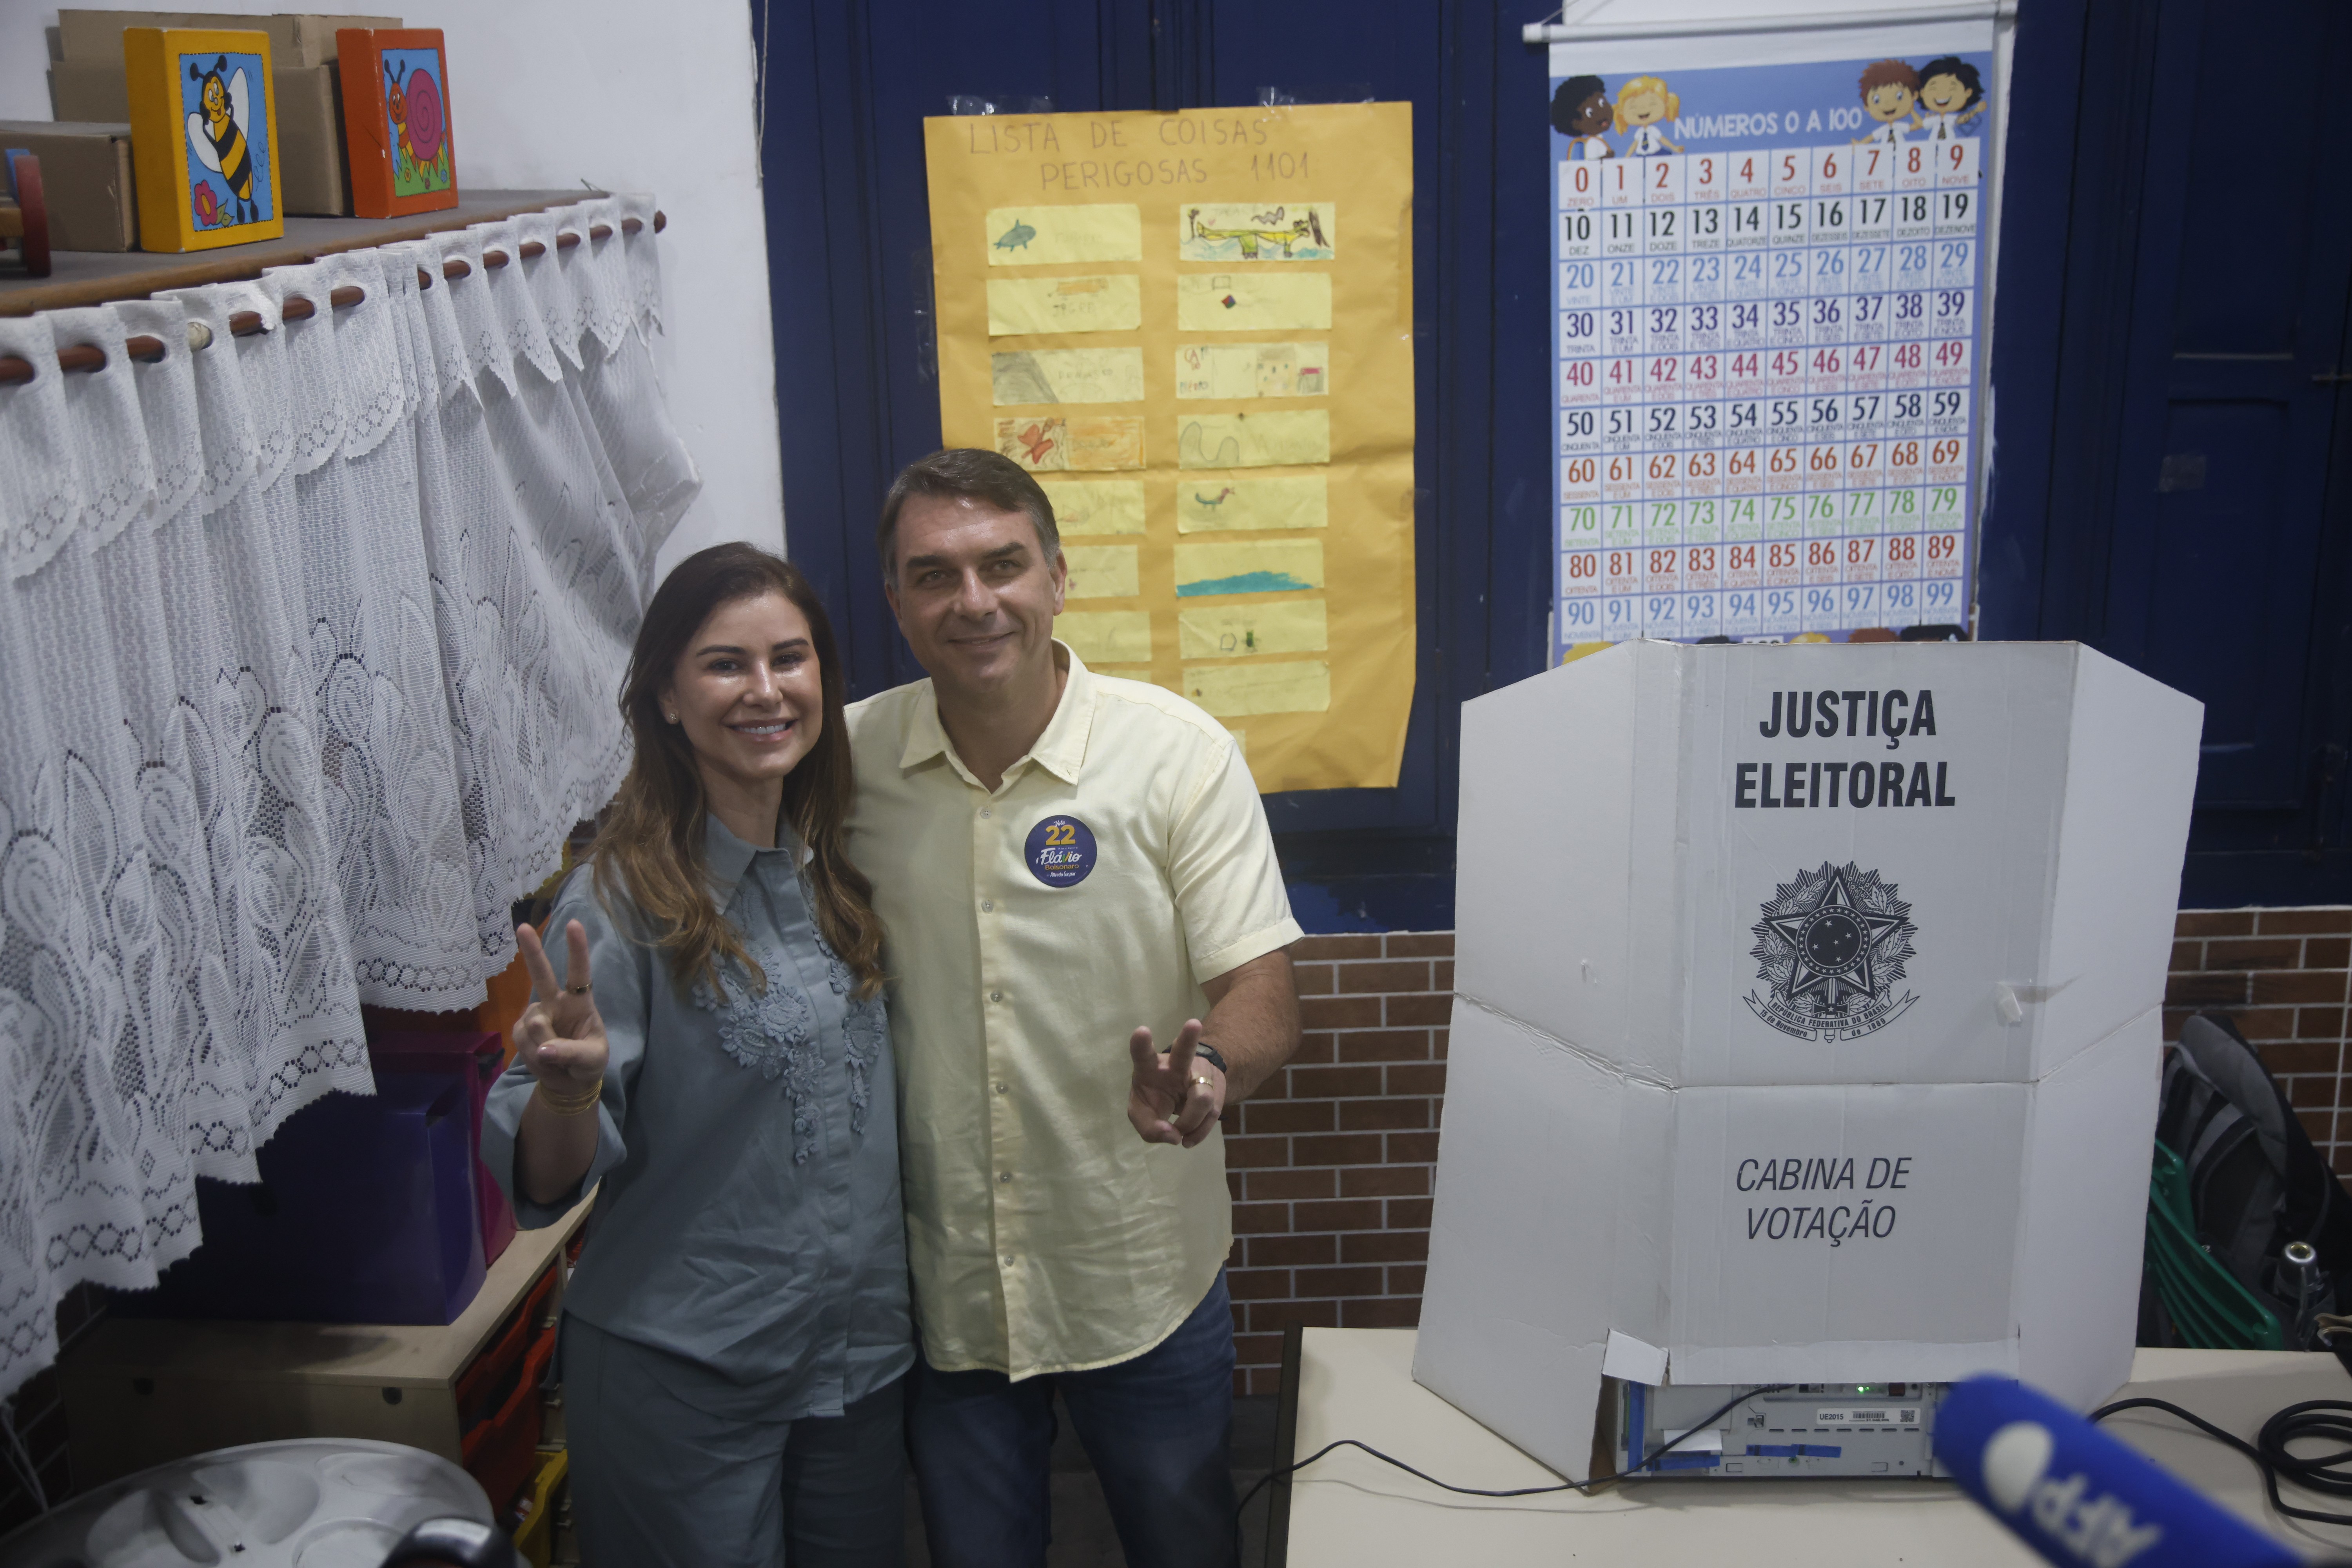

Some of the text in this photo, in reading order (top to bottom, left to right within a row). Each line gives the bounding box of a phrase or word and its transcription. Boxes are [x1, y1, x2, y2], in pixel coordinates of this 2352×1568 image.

[970, 118, 1267, 154] LISTA DE COISAS
[1673, 107, 1862, 140] NÚMEROS 0 A 100
[1041, 152, 1309, 191] PERIGOSAS 1101
[1575, 144, 1964, 192] 0 1 2 3 4 5 6 7 8 9
[1568, 174, 1969, 207] ZERO UM DOIS TRÊS QUATRO CINCO SEIS SETE OITO NOVE
[1564, 192, 1969, 241] 10 11 12 13 14 15 16 17 18 19
[1569, 246, 1589, 255] DEZ
[1607, 243, 1635, 253] ONZE
[1649, 241, 1677, 252] DOZE
[1693, 238, 1719, 249] TREZE
[1727, 236, 1766, 247] QUATORZE
[1772, 234, 1804, 244] QUINZE
[1896, 226, 1930, 237] DEZOITO
[1935, 224, 1976, 234] DEZENOVE
[1567, 242, 1969, 289] 20 21 22 23 24 25 26 27 28 29
[1566, 290, 1965, 338] 30 31 32 33 34 35 36 37 38 39
[1566, 341, 1964, 387] 40 41 42 43 44 45 46 47 48 49
[1566, 391, 1961, 437] 50 51 52 53 54 55 56 57 58 59
[1568, 439, 1960, 483] 60 61 62 63 64 65 66 67 68 69
[1571, 488, 1957, 531] 70 71 72 73 74 75 76 77 78 79
[1570, 534, 1955, 579] 80 81 82 83 84 85 86 87 88 89
[1568, 582, 1954, 625] 90 91 92 93 94 95 96 97 98 99
[1759, 689, 1936, 750] JUSTIÇA
[1735, 761, 1956, 808] ELEITORAL
[1040, 847, 1082, 865] Flávio
[1045, 825, 1076, 846] 22
[1771, 1002, 1888, 1027] REPÚBLICA FEDERATIVA DO BRASIL
[1775, 1020, 1808, 1037] Novembro
[1867, 1018, 1886, 1031] 1889
[1736, 1157, 1912, 1191] CABINA DE
[1748, 1199, 1896, 1247] VOTAÇÃO
